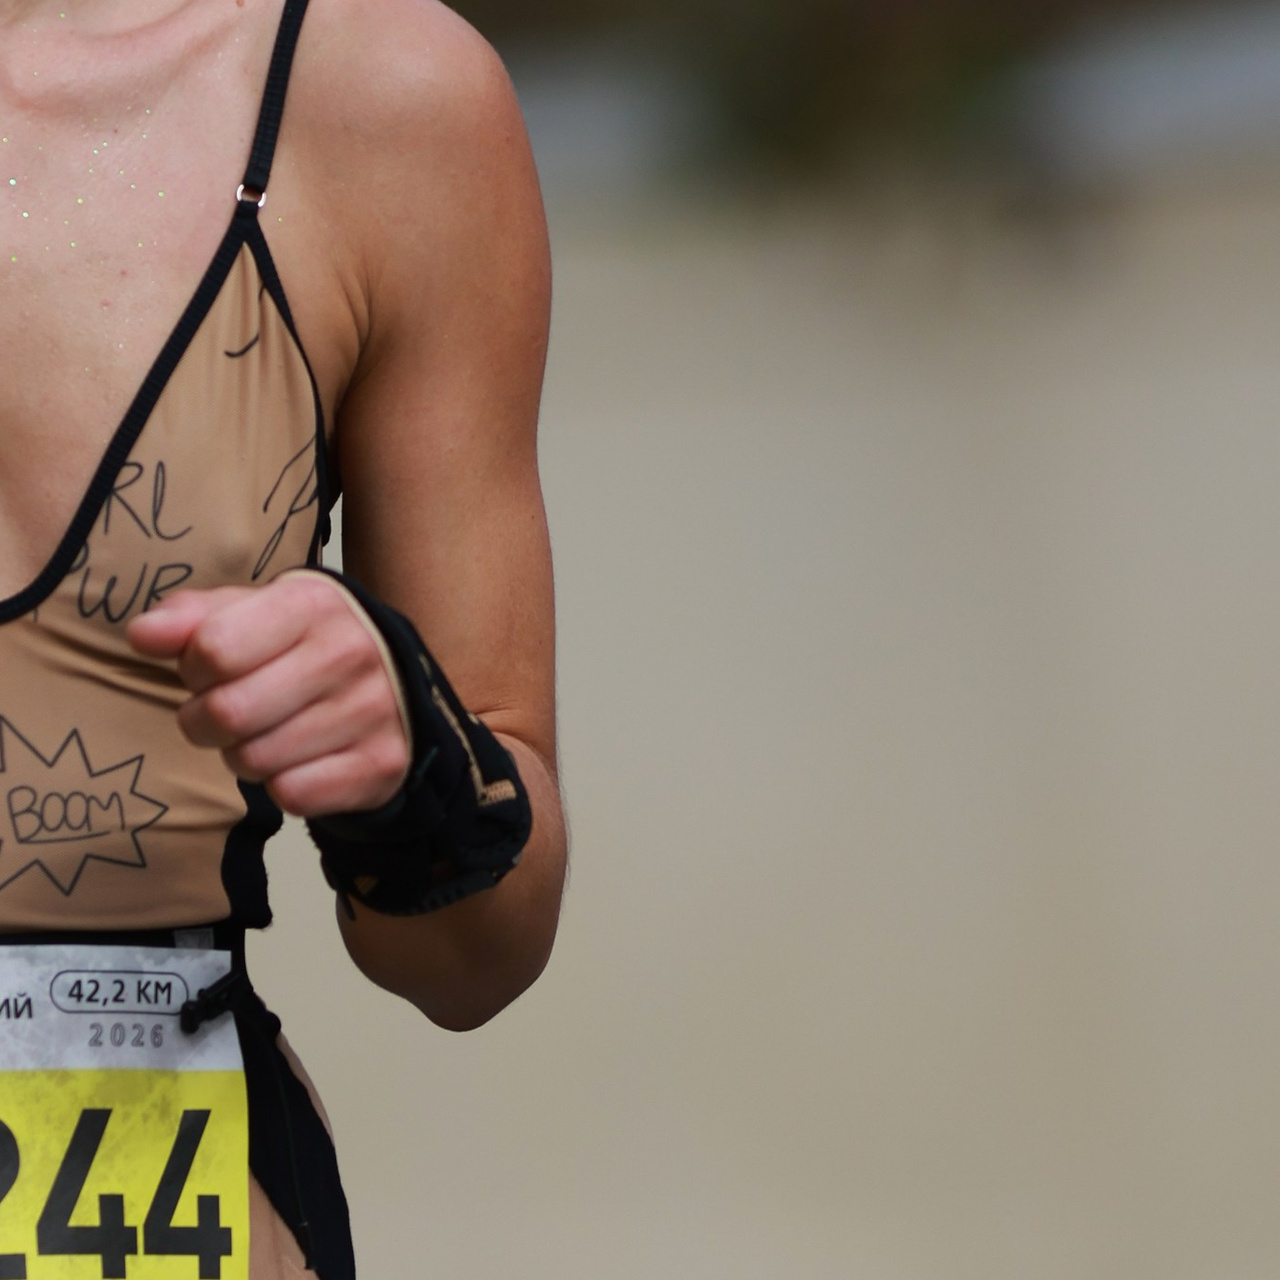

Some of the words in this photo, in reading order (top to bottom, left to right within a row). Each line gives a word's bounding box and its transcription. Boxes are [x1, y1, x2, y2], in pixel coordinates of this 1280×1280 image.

[7, 785, 125, 842] BOOM
[67, 978, 125, 1007] 42,2
[135, 980, 173, 1006] КМ
[88, 1023, 164, 1049] 2026
